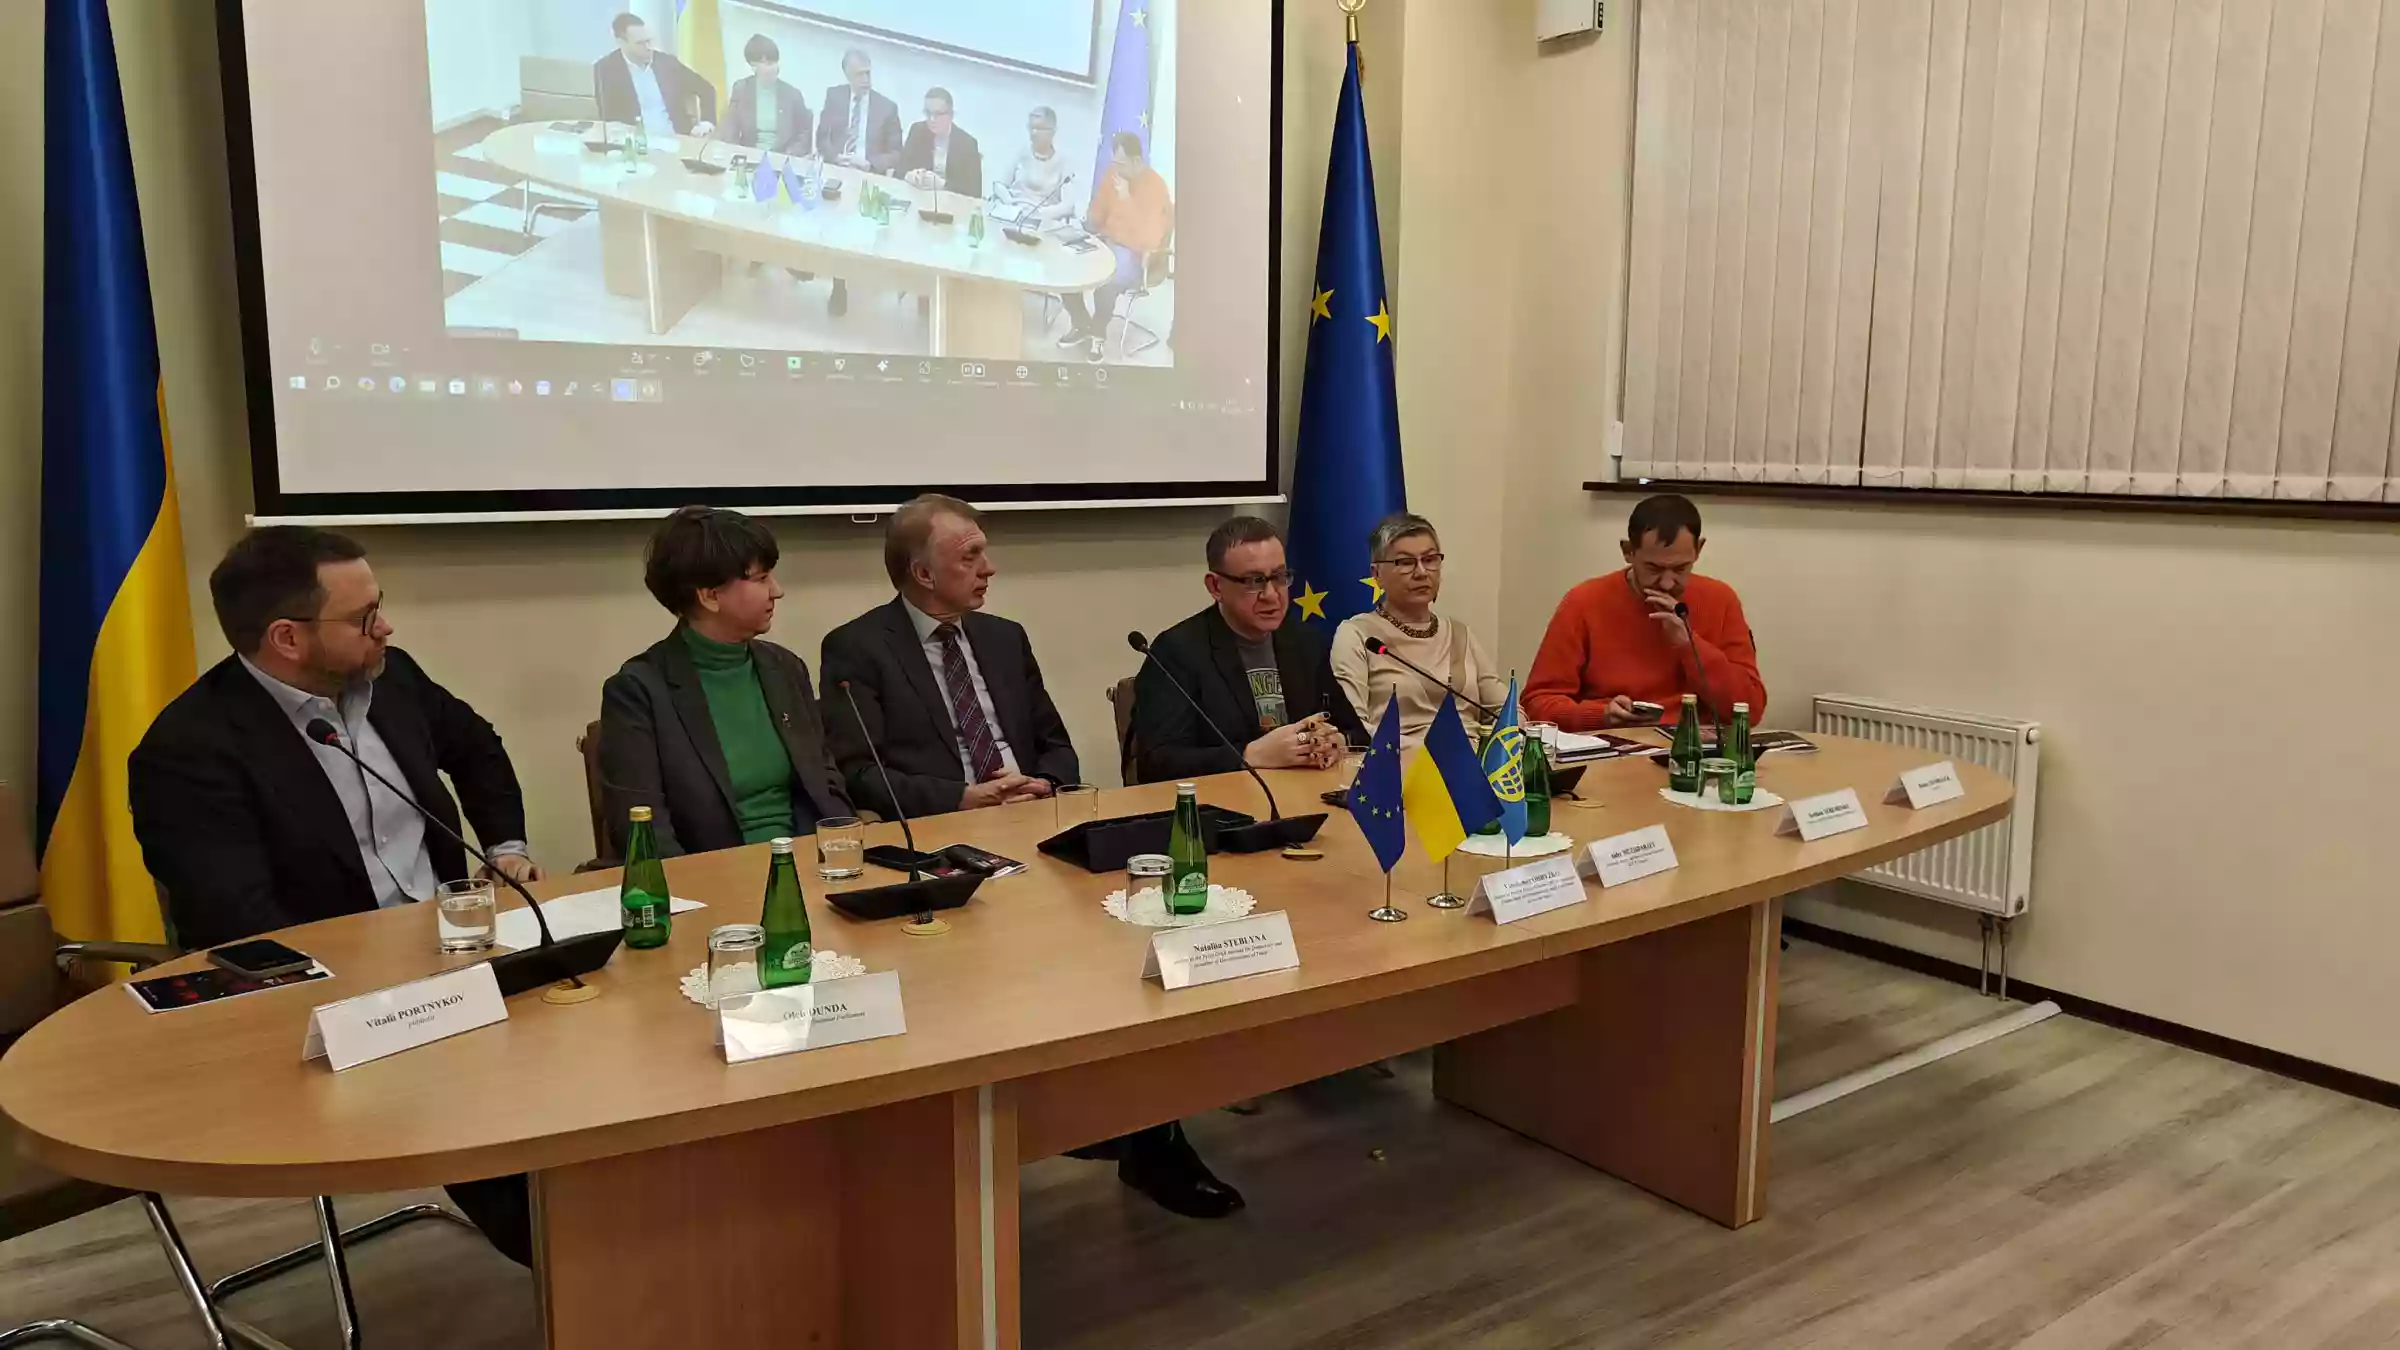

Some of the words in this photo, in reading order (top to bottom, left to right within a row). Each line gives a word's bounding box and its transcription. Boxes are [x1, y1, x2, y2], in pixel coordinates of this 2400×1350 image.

[1223, 934, 1267, 948] STEBLYNA
[366, 1013, 396, 1028] Vitalii
[398, 992, 465, 1020] PORTNYKOV
